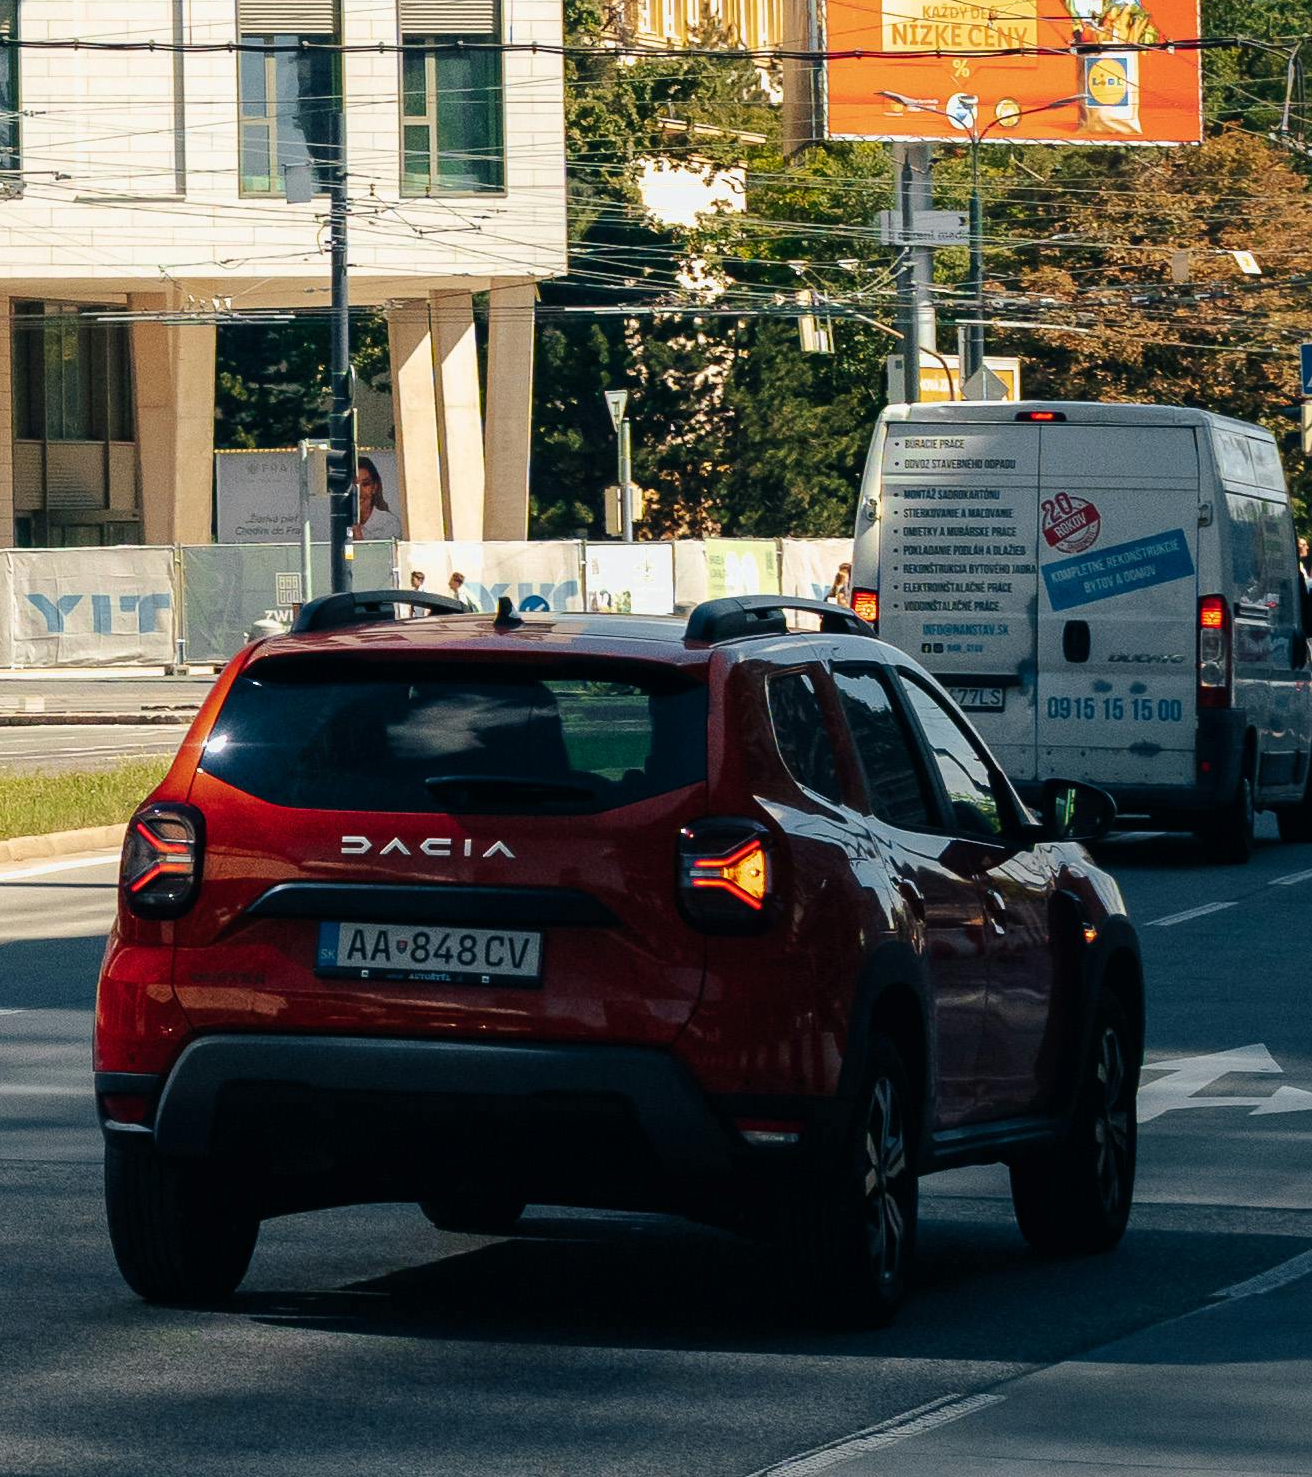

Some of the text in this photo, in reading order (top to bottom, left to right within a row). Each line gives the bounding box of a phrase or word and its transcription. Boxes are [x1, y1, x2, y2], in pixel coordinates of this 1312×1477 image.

[968, 25, 1028, 48] CENY
[1041, 492, 1073, 523] 20
[1053, 511, 1087, 539] ROKOV
[26, 594, 170, 635] YIT
[341, 835, 516, 859] DACIA
[320, 948, 336, 960] SK
